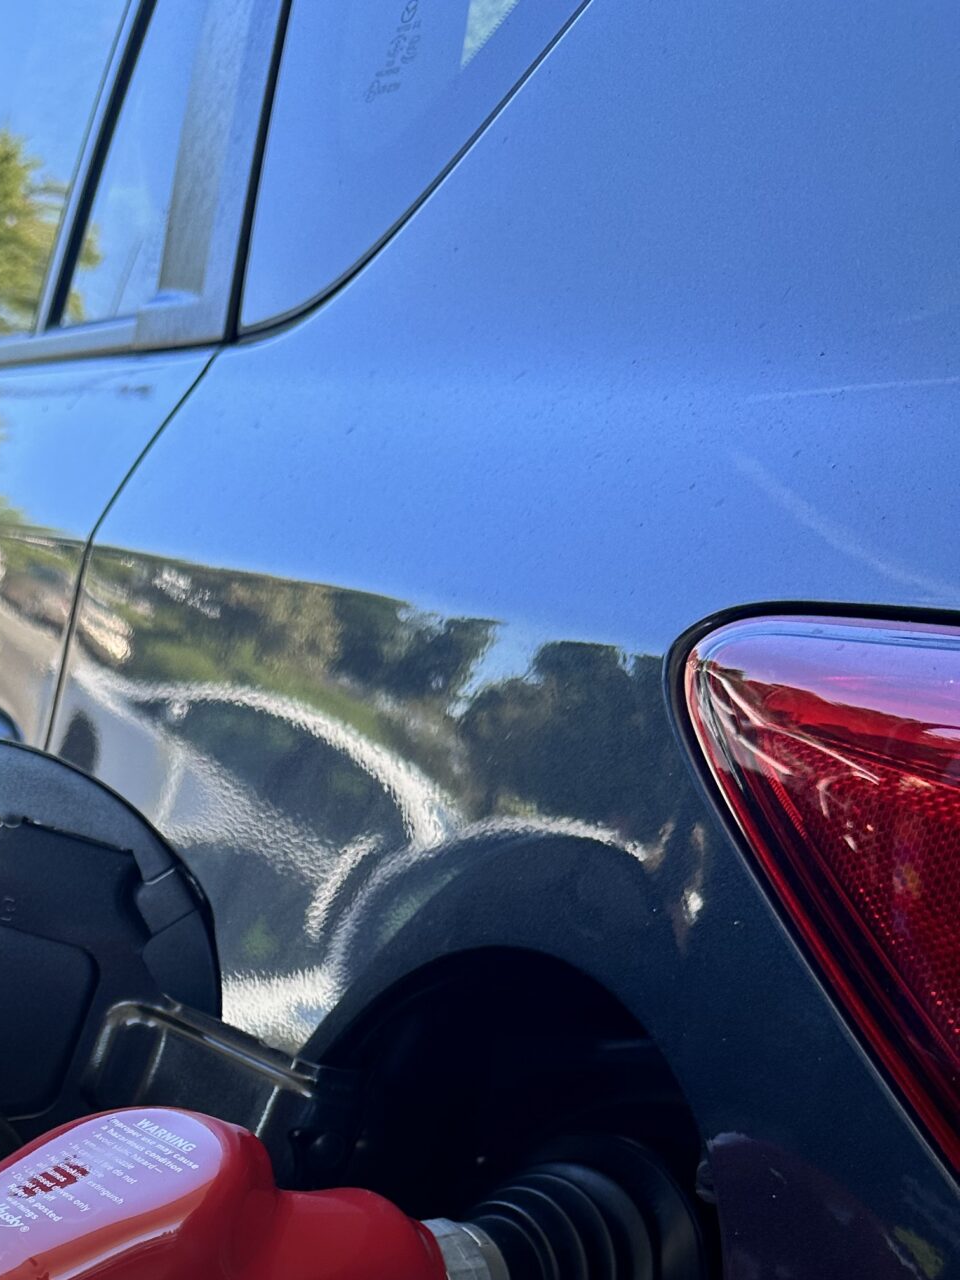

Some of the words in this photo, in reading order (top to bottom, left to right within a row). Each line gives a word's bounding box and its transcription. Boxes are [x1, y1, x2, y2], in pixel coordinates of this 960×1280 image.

[136, 1117, 197, 1153] WARNING
[139, 1135, 154, 1145] use
[154, 1142, 173, 1155] may
[172, 1153, 200, 1170] cause
[143, 1149, 183, 1173] condition
[12, 1173, 23, 1182] Do
[111, 1168, 124, 1177] do
[121, 1174, 136, 1185] not
[32, 1201, 63, 1222] posted
[72, 1198, 91, 1212] only
